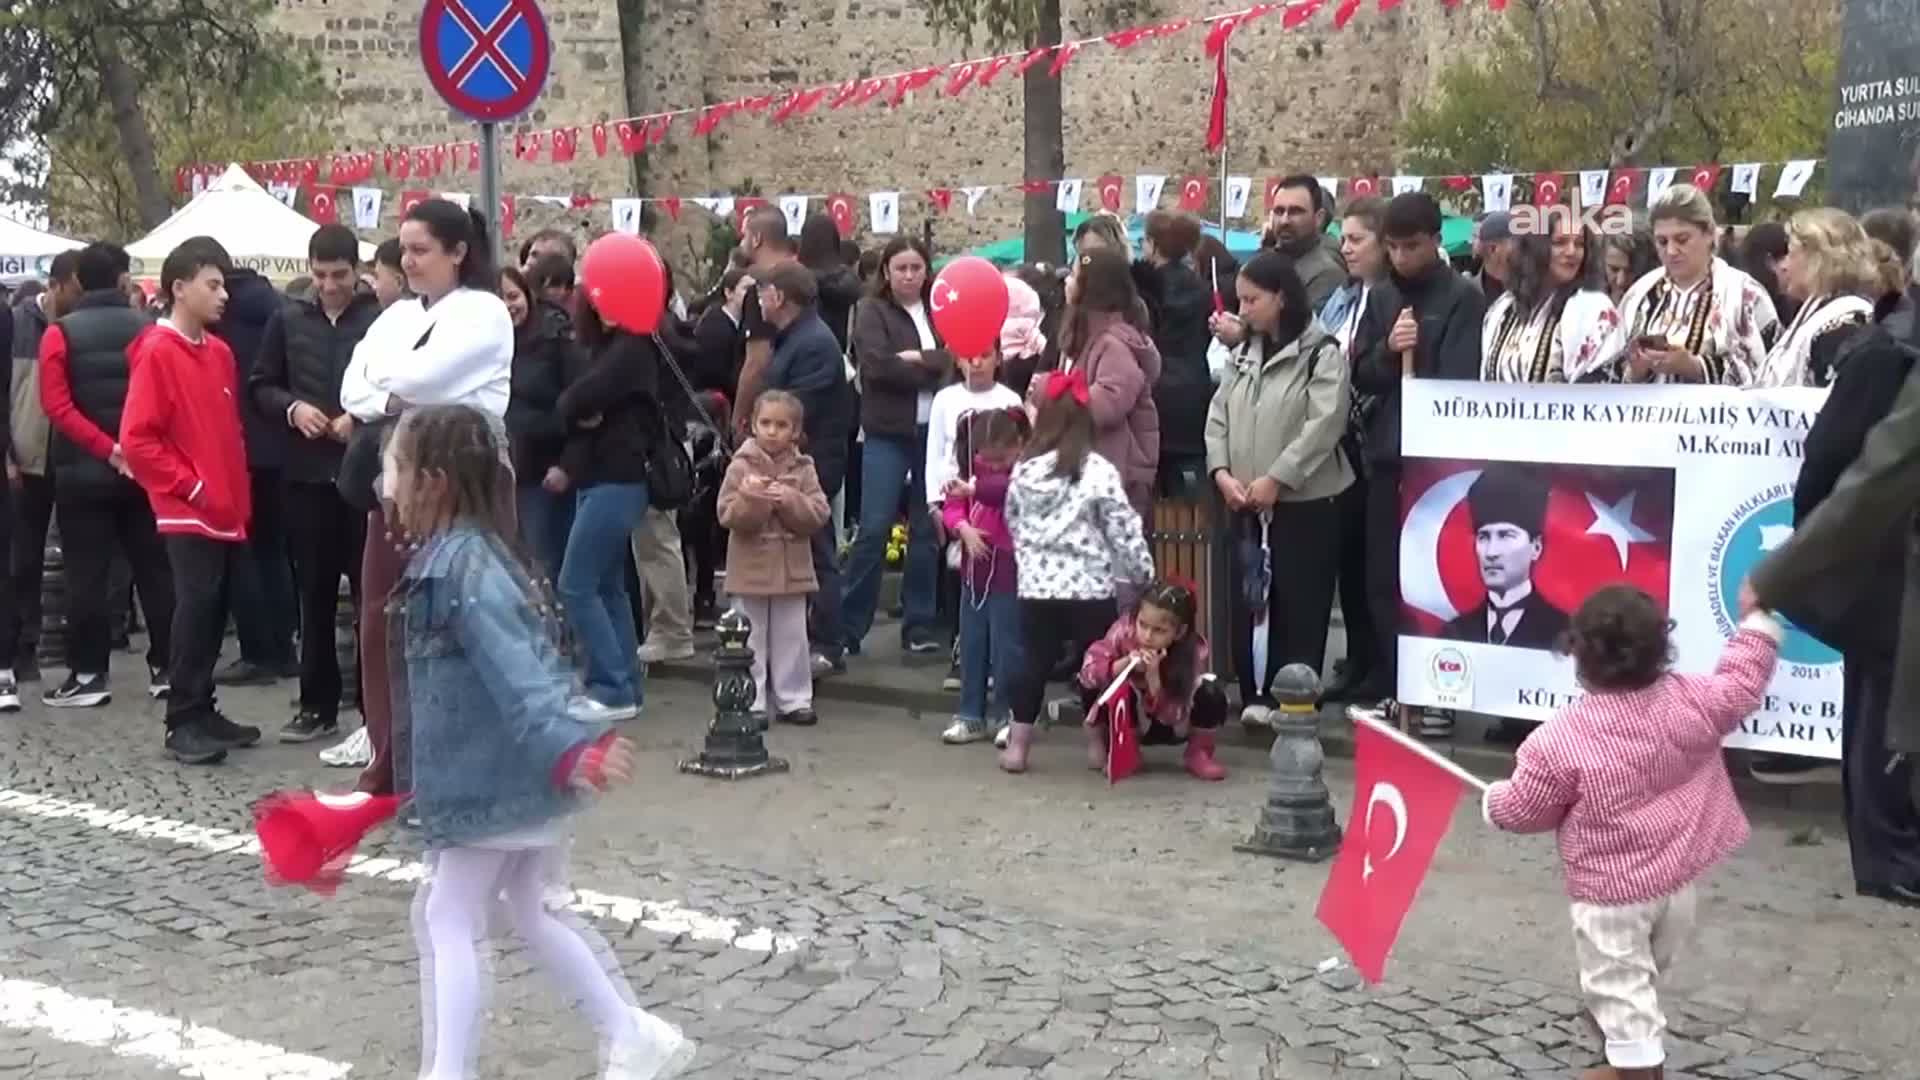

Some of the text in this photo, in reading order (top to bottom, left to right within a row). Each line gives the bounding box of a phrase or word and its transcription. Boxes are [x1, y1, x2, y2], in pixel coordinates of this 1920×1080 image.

[1841, 80, 1893, 104] YURTTA
[1834, 104, 1895, 129] CİHANDA
[1432, 396, 1820, 431] MÜBADİLLER KAYBEDİLMİŞ VATA
[1677, 433, 1770, 457] M.Kemal
[1791, 664, 1821, 680] 2014
[1518, 687, 1584, 709] KÜLT
